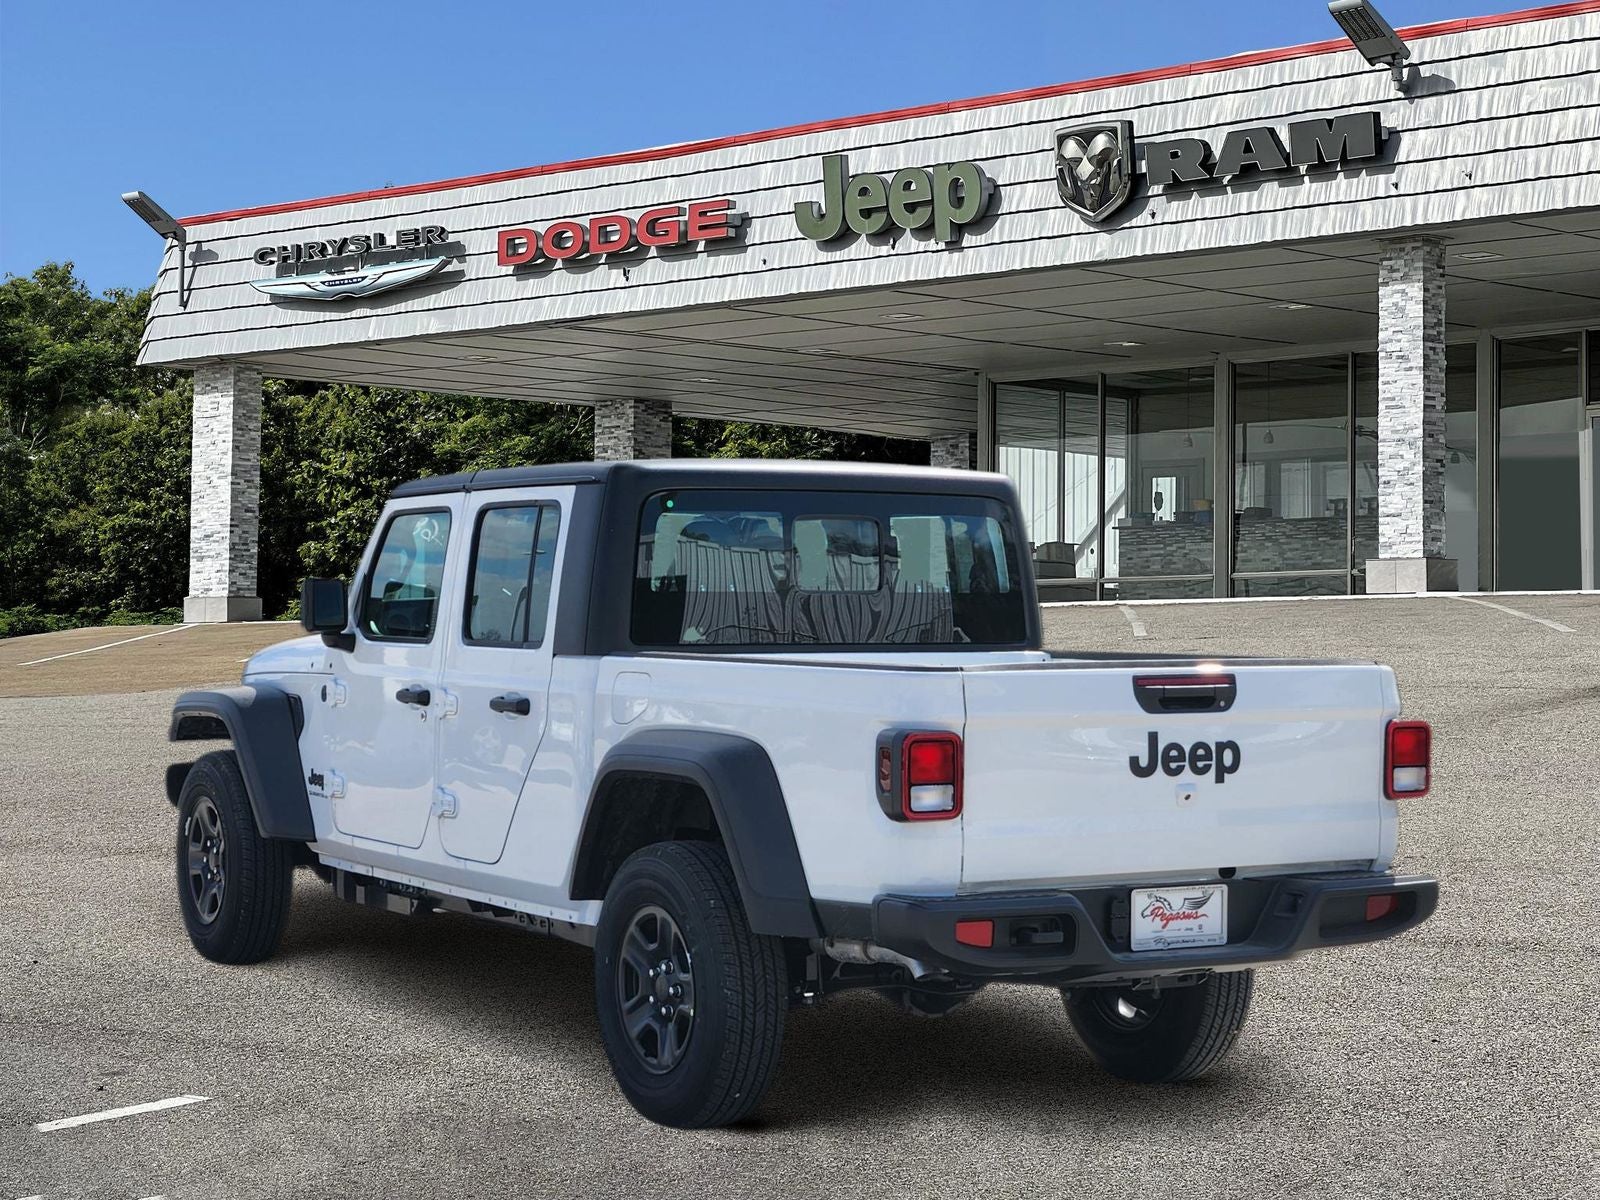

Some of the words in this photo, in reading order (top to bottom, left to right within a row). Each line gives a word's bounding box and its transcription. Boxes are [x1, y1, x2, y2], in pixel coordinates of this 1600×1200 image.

[1144, 111, 1382, 187] RAM
[794, 154, 994, 242] Jeep
[253, 225, 448, 265] CHRYSLER
[497, 199, 736, 266] DODGE
[324, 278, 362, 286] CHRYSLER
[308, 768, 324, 791] Jeep
[1129, 731, 1241, 784] Jeep
[1150, 906, 1208, 929] Pegasus
